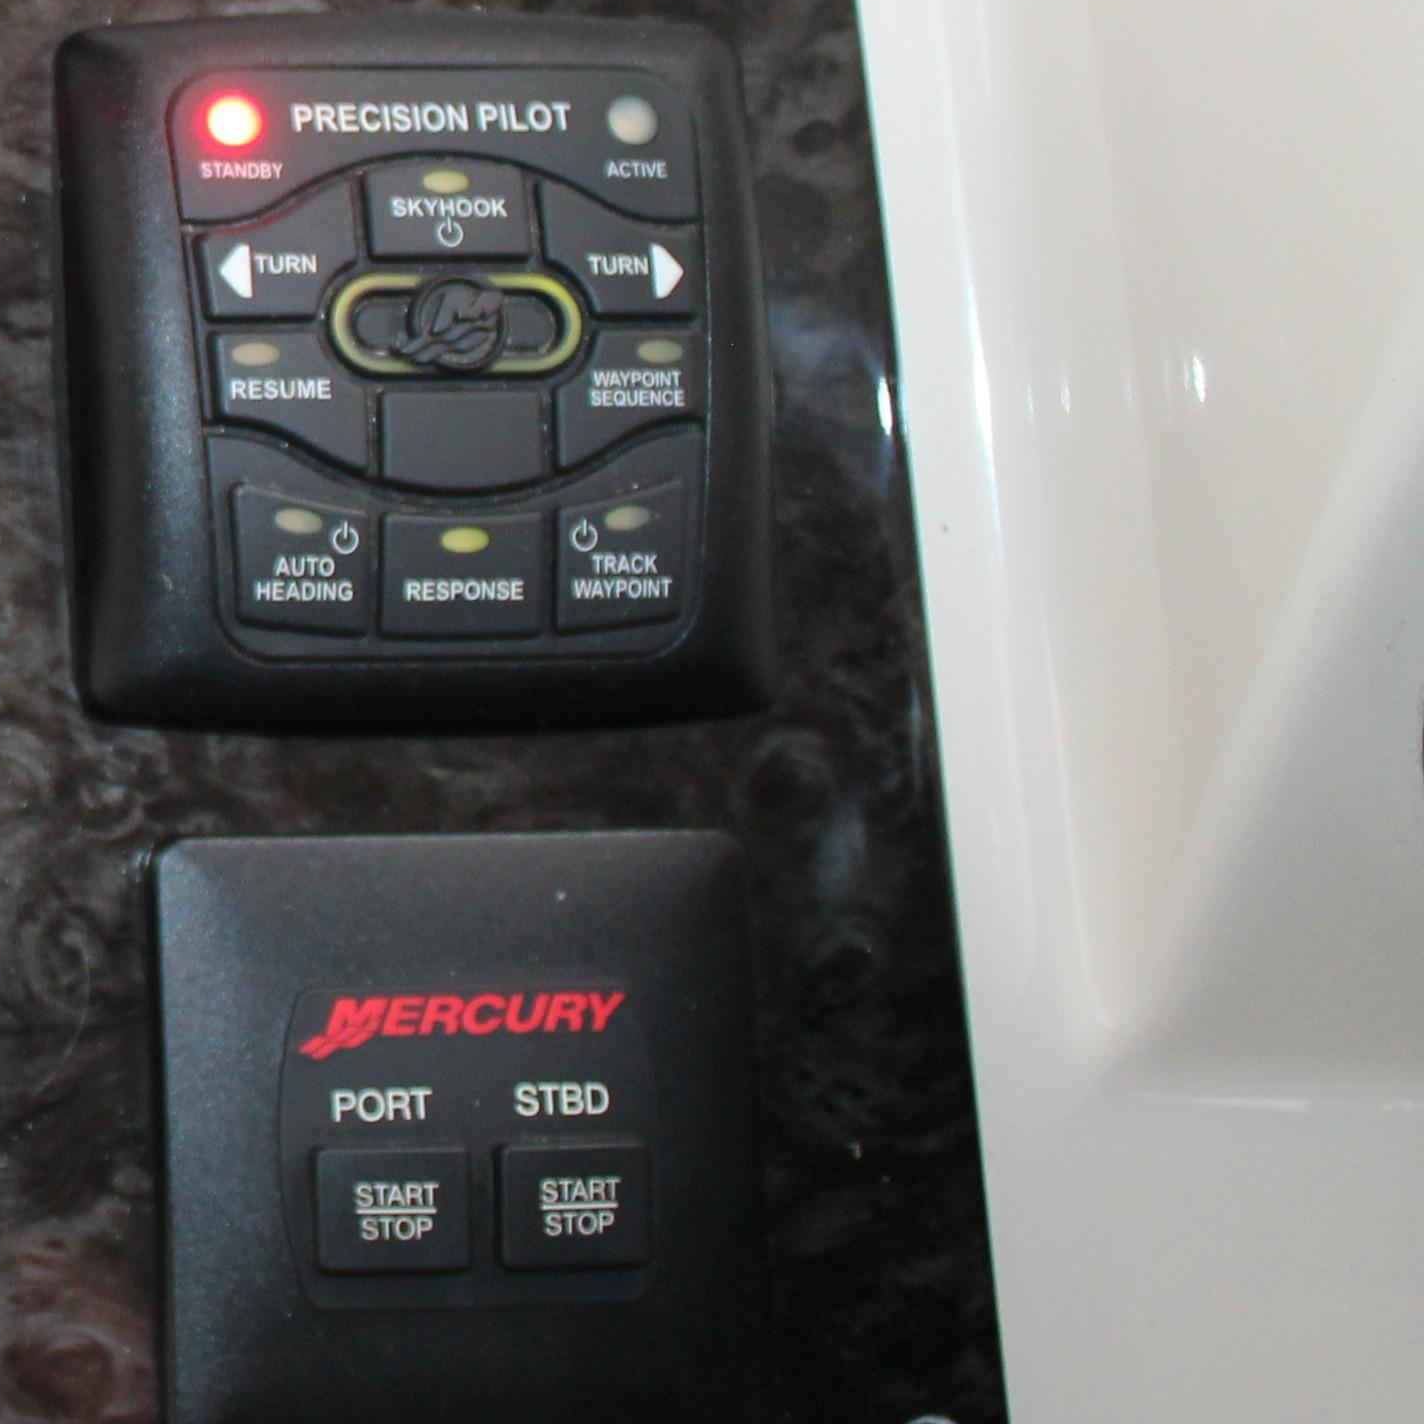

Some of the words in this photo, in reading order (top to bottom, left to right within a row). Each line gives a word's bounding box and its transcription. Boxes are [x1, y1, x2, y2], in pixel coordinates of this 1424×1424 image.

[290, 102, 469, 135] PRECISION
[478, 101, 571, 134] PILOT
[200, 161, 284, 181] STANDBY
[607, 160, 668, 180] ACTIVE
[390, 197, 508, 220] SKYHOOK
[255, 253, 319, 276] TURN
[588, 253, 650, 276] TURN
[230, 379, 333, 402] RESUME
[593, 370, 683, 390] WAYPOINT
[590, 389, 685, 408] SEQUENCE
[275, 555, 336, 579] AUTO
[592, 553, 658, 575] TRACK
[255, 581, 355, 603] HEADING
[405, 580, 525, 603] RESPONSE
[572, 577, 674, 601] WAYPOINT
[299, 992, 626, 1060] MERCURY
[332, 1086, 433, 1122] PORT
[513, 1082, 610, 1117] STBD
[355, 1182, 440, 1208] START
[540, 1177, 621, 1204] START
[360, 1214, 434, 1241] STOP
[543, 1211, 616, 1237] STOP
